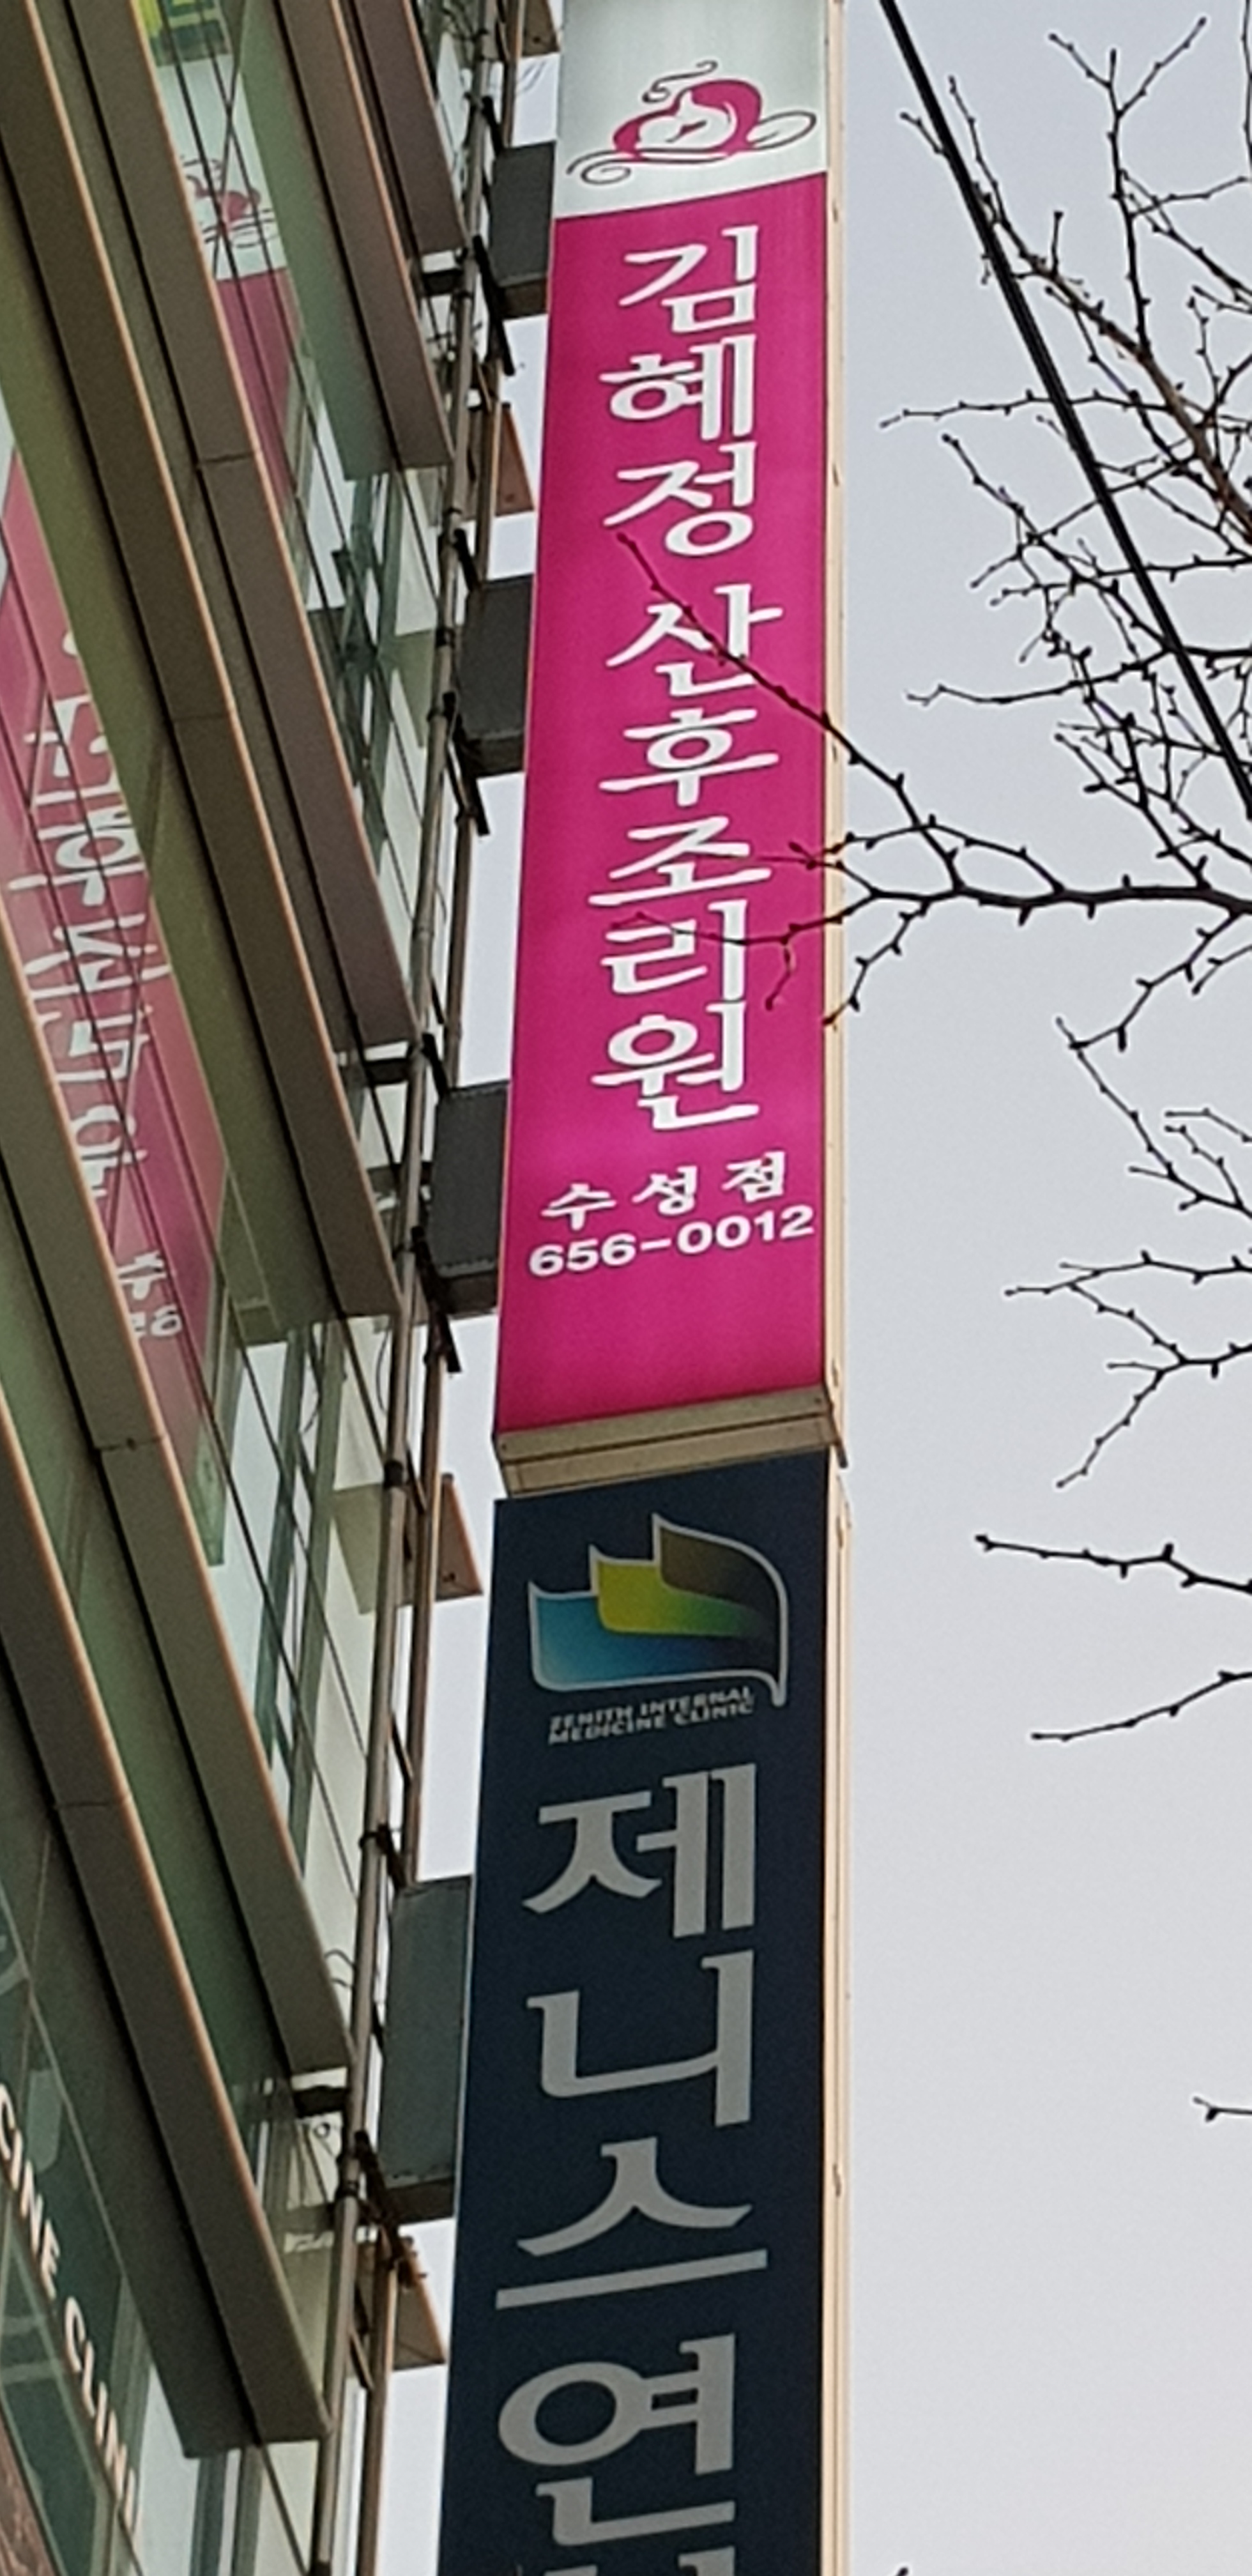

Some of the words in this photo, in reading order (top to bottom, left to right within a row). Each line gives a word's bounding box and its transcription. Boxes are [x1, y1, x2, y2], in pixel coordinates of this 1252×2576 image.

[599, 224, 758, 557] 김혜정
[588, 583, 785, 1131] 산후조리원
[529, 1205, 814, 1276] 656-0012
[541, 1150, 787, 1230] 수성점
[548, 1715, 666, 1745] MEDICINE
[673, 1700, 754, 1726] CLINIC
[549, 1706, 634, 1730] ZENITH
[640, 1687, 751, 1716] INTERNAL
[495, 1763, 767, 2576] 제니스연
[65, 2296, 142, 2556] CLINI
